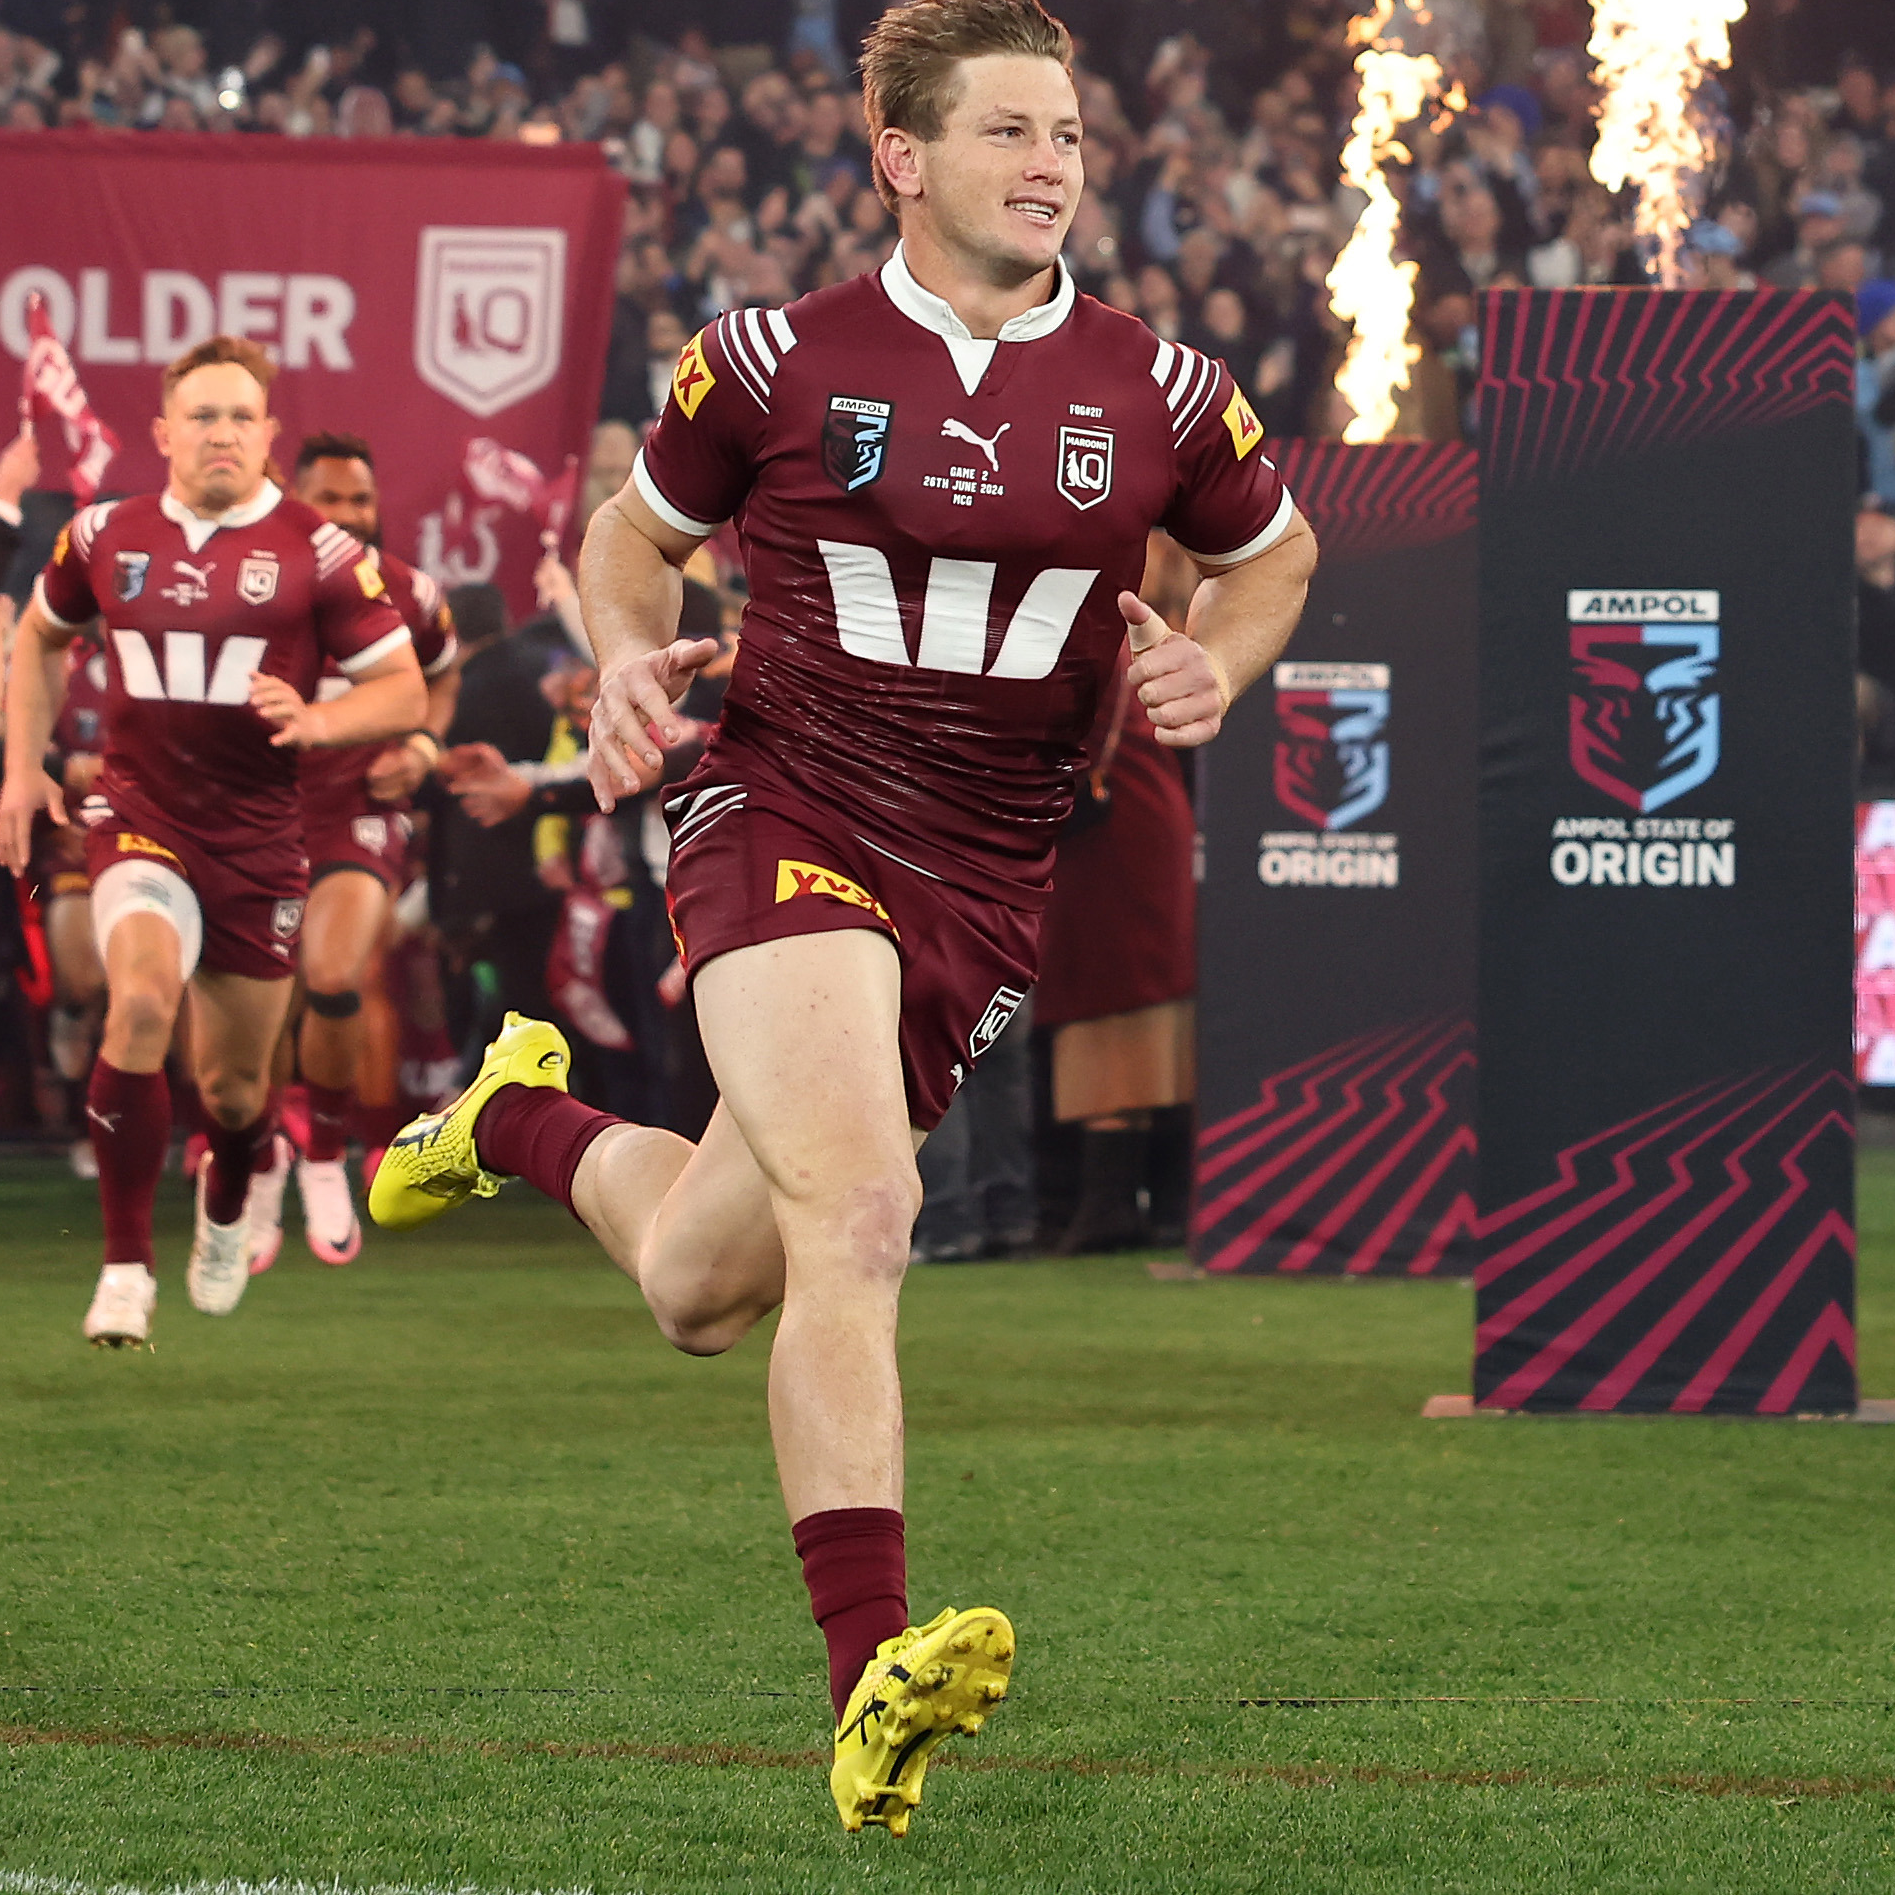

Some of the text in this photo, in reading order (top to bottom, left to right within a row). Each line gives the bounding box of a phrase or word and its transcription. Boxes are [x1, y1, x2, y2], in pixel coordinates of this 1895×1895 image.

[835, 399, 886, 414] AMPOL
[1069, 403, 1104, 418] FOG#217
[1066, 435, 1108, 450] MAROONS
[949, 466, 989, 481] GAME 2
[923, 475, 1004, 496] 26TH JUNE 2024
[952, 492, 973, 507] MCG
[1582, 596, 1707, 615] AMPOL
[1552, 817, 1735, 840] AMPOL STATE OF
[1258, 849, 1399, 887] ORIGIN
[1550, 840, 1736, 886] ORIGIN
